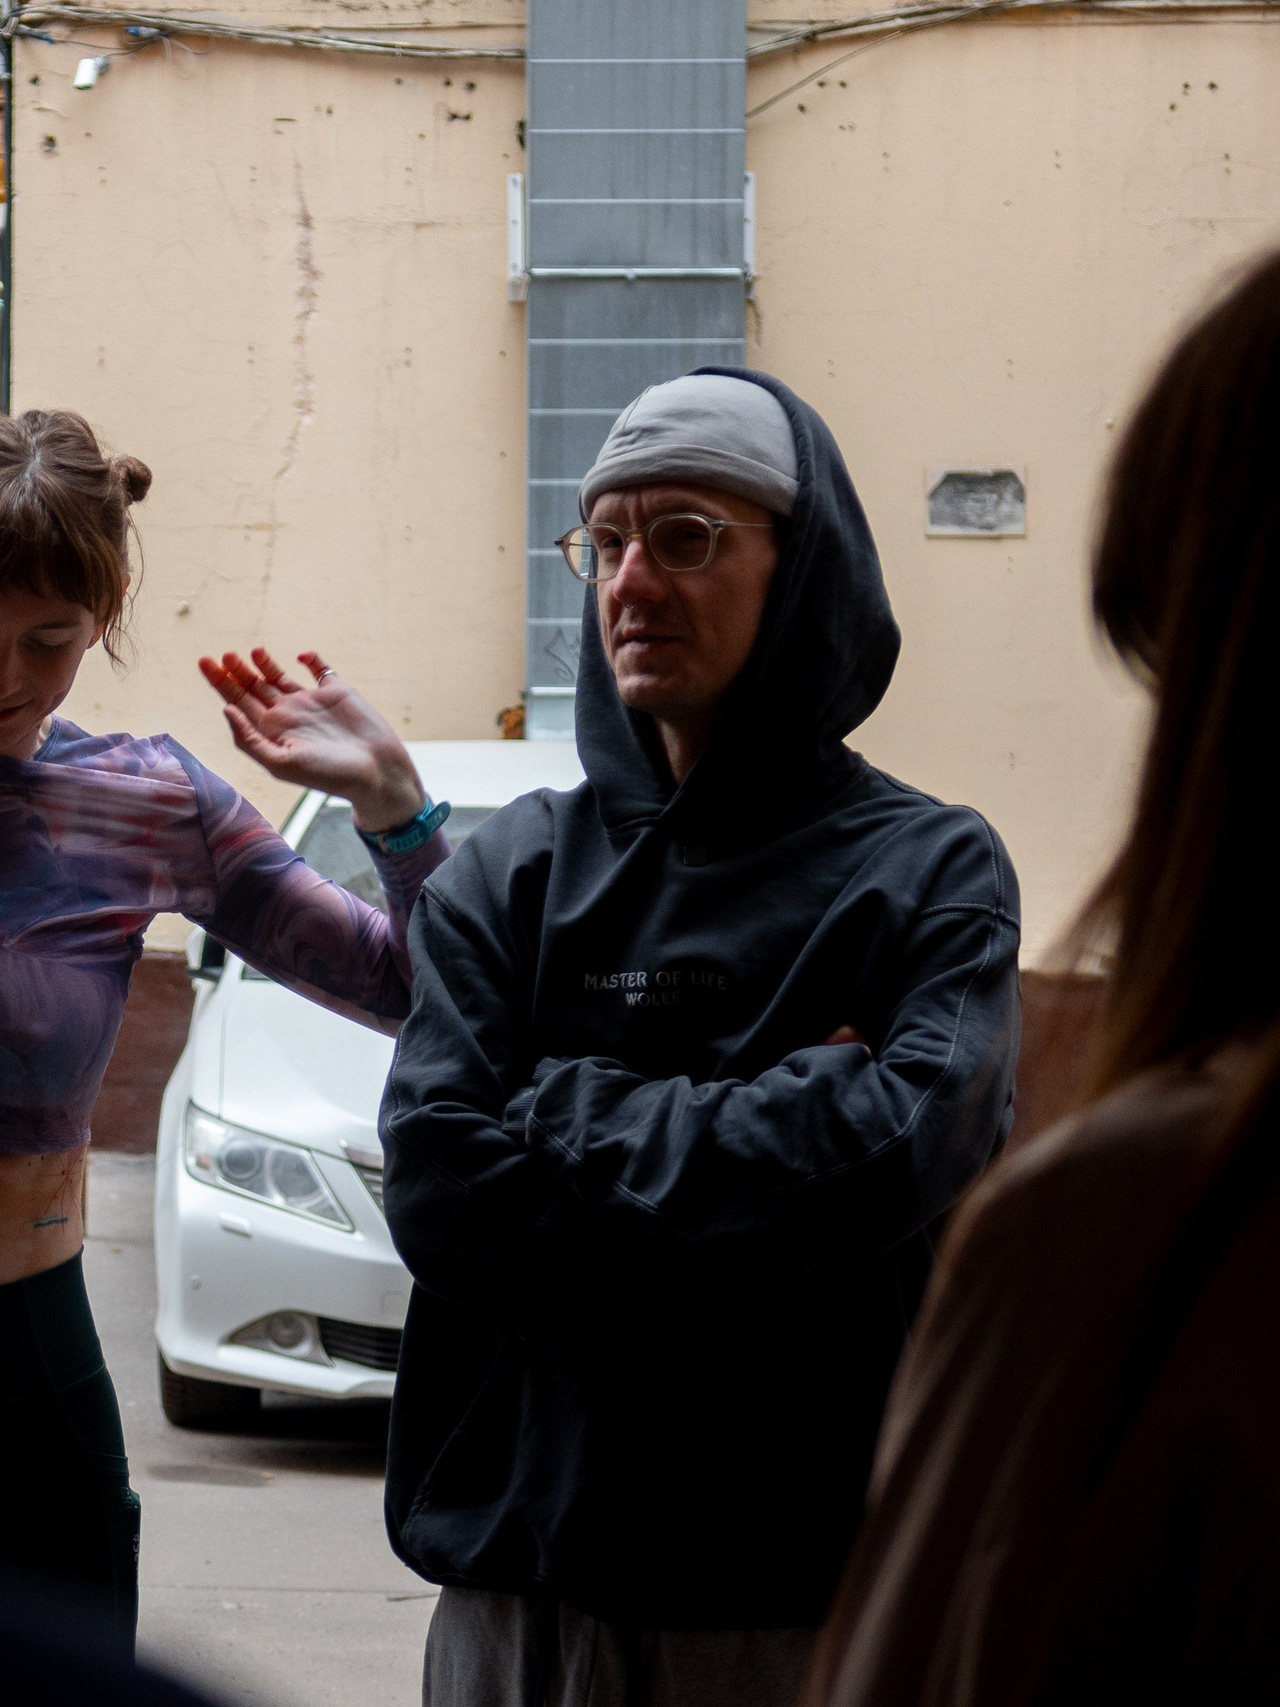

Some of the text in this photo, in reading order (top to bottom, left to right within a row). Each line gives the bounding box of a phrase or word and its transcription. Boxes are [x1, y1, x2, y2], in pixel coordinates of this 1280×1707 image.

[583, 970, 727, 991] MASTER OF LIFE
